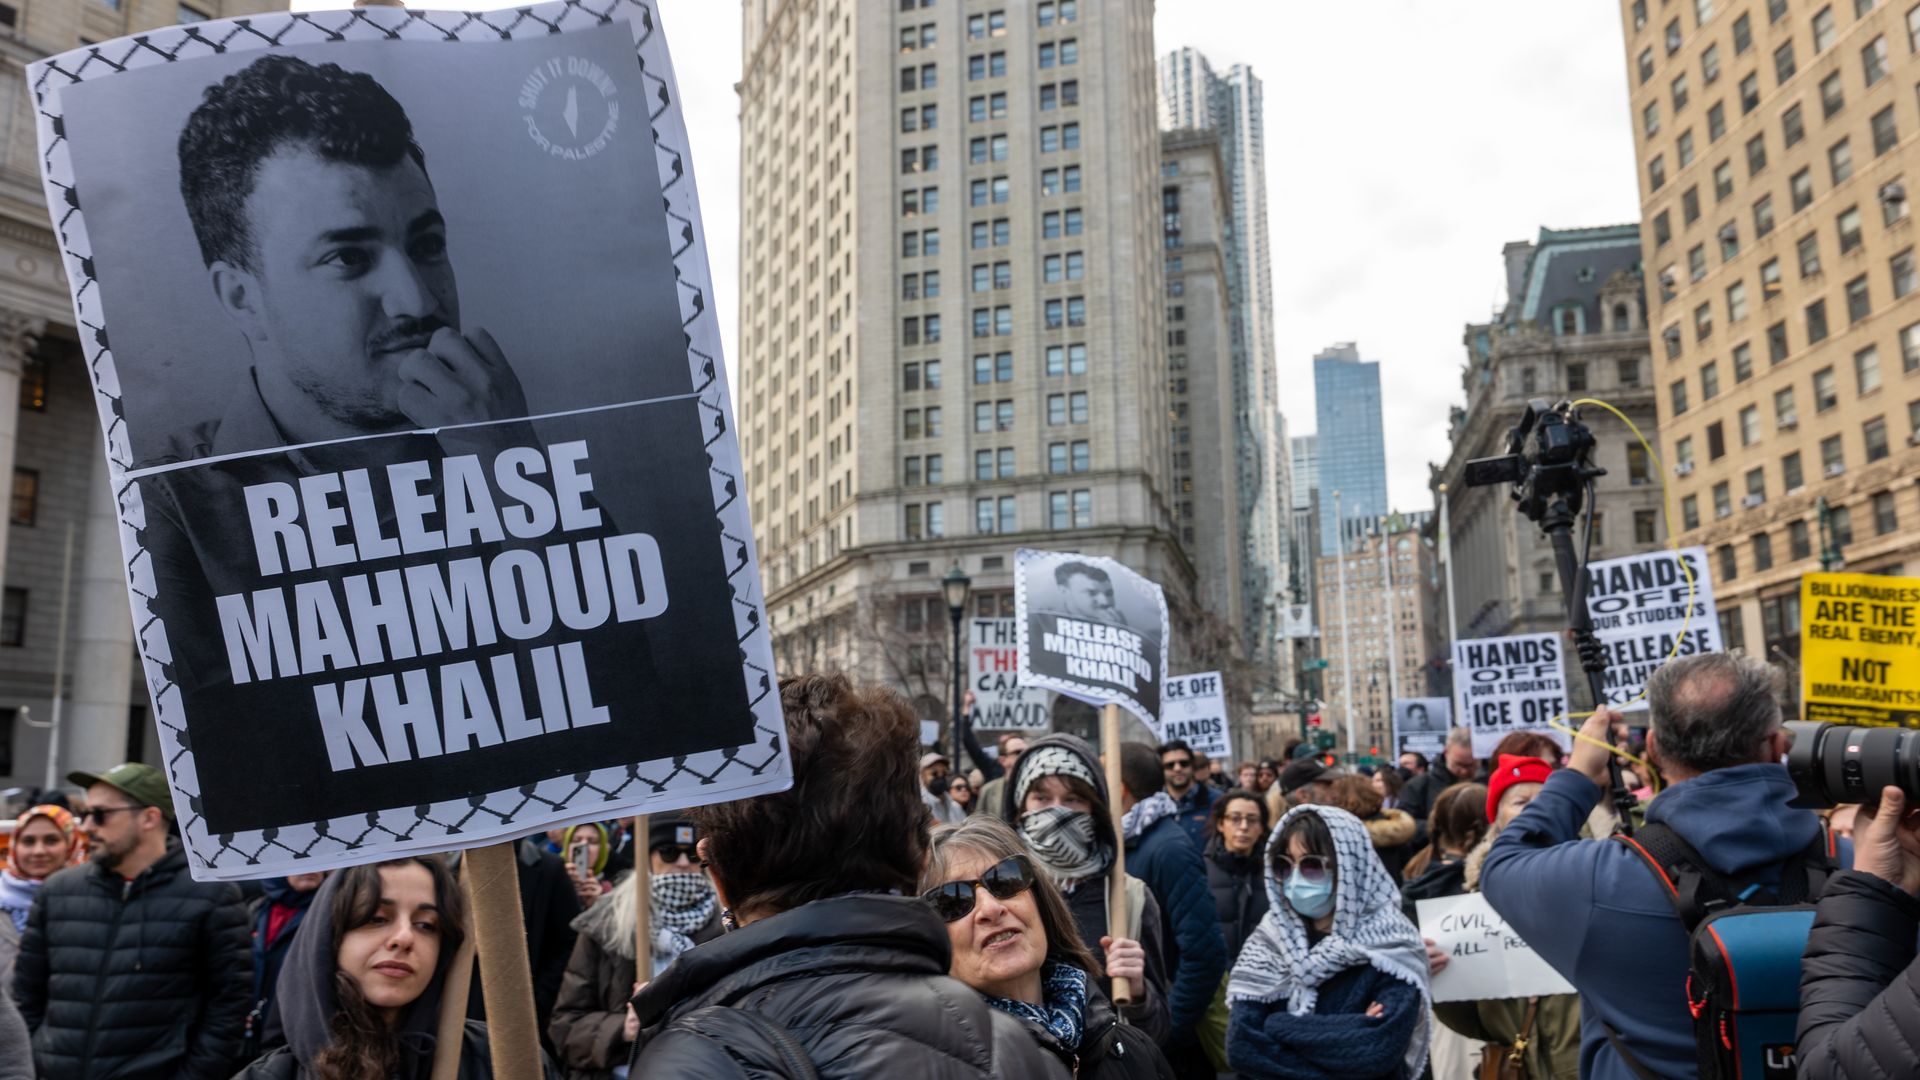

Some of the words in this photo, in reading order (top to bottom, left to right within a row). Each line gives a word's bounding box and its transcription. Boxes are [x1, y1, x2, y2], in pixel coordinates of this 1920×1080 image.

[518, 66, 549, 110] SHUT
[546, 57, 562, 79] IT
[522, 114, 550, 151] FOR
[550, 100, 619, 160] PALESTINE
[243, 440, 602, 576] RELEASE
[1589, 554, 1698, 598] HANDS
[1592, 585, 1699, 613] OFF
[1810, 582, 1920, 602] BILLIONAIRES
[215, 533, 669, 685] MAHMOUD
[1592, 615, 1621, 631] OUR
[1627, 603, 1706, 626] STUDENTS
[1815, 601, 1864, 623] ARE
[1869, 604, 1915, 627] THE
[1056, 617, 1142, 655] RELEASE
[1809, 625, 1853, 641] REAL
[1043, 632, 1152, 683] MAHMOUD
[1468, 638, 1557, 669] HANDS
[1601, 629, 1711, 666] RELEASE
[1066, 656, 1139, 693] KHALIL
[1472, 664, 1557, 682] OFF
[1842, 658, 1892, 685] NOT
[1167, 680, 1185, 697] CE
[1191, 677, 1216, 694] OFF
[1471, 684, 1495, 696] OUR
[1499, 679, 1561, 694] STUDENTS
[312, 641, 611, 772] KHALIL
[1473, 701, 1512, 727] ICE
[1521, 698, 1564, 723] OFF
[1166, 717, 1222, 739] HANDS
[1440, 913, 1489, 932] CIVIL
[1452, 942, 1488, 956] ALL
[1504, 935, 1528, 950] PEO
